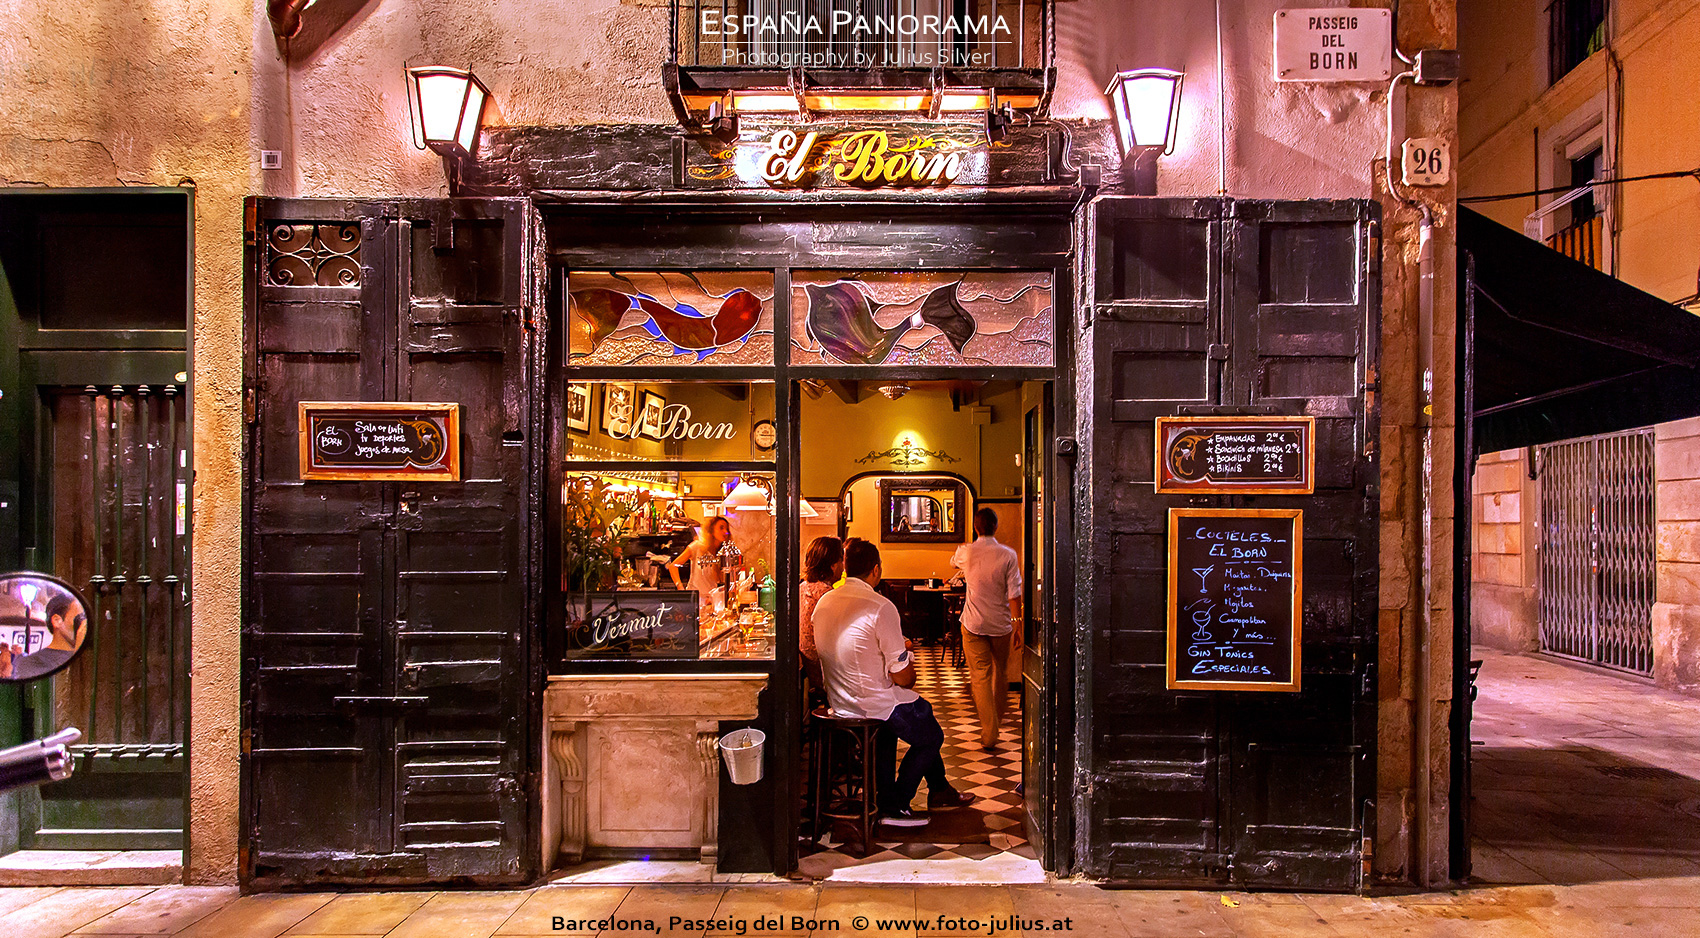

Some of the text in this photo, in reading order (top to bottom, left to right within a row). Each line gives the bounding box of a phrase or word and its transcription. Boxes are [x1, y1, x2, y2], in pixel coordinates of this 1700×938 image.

[1309, 17, 1358, 30] PASSEIG
[1322, 35, 1345, 47] DEL
[1310, 52, 1358, 69] BORN
[758, 130, 964, 183] El Born
[1413, 148, 1442, 174] 26
[608, 403, 737, 440] El Born
[325, 426, 338, 435] EL
[1209, 543, 1267, 558] EL BORN
[592, 602, 673, 644] Vermut
